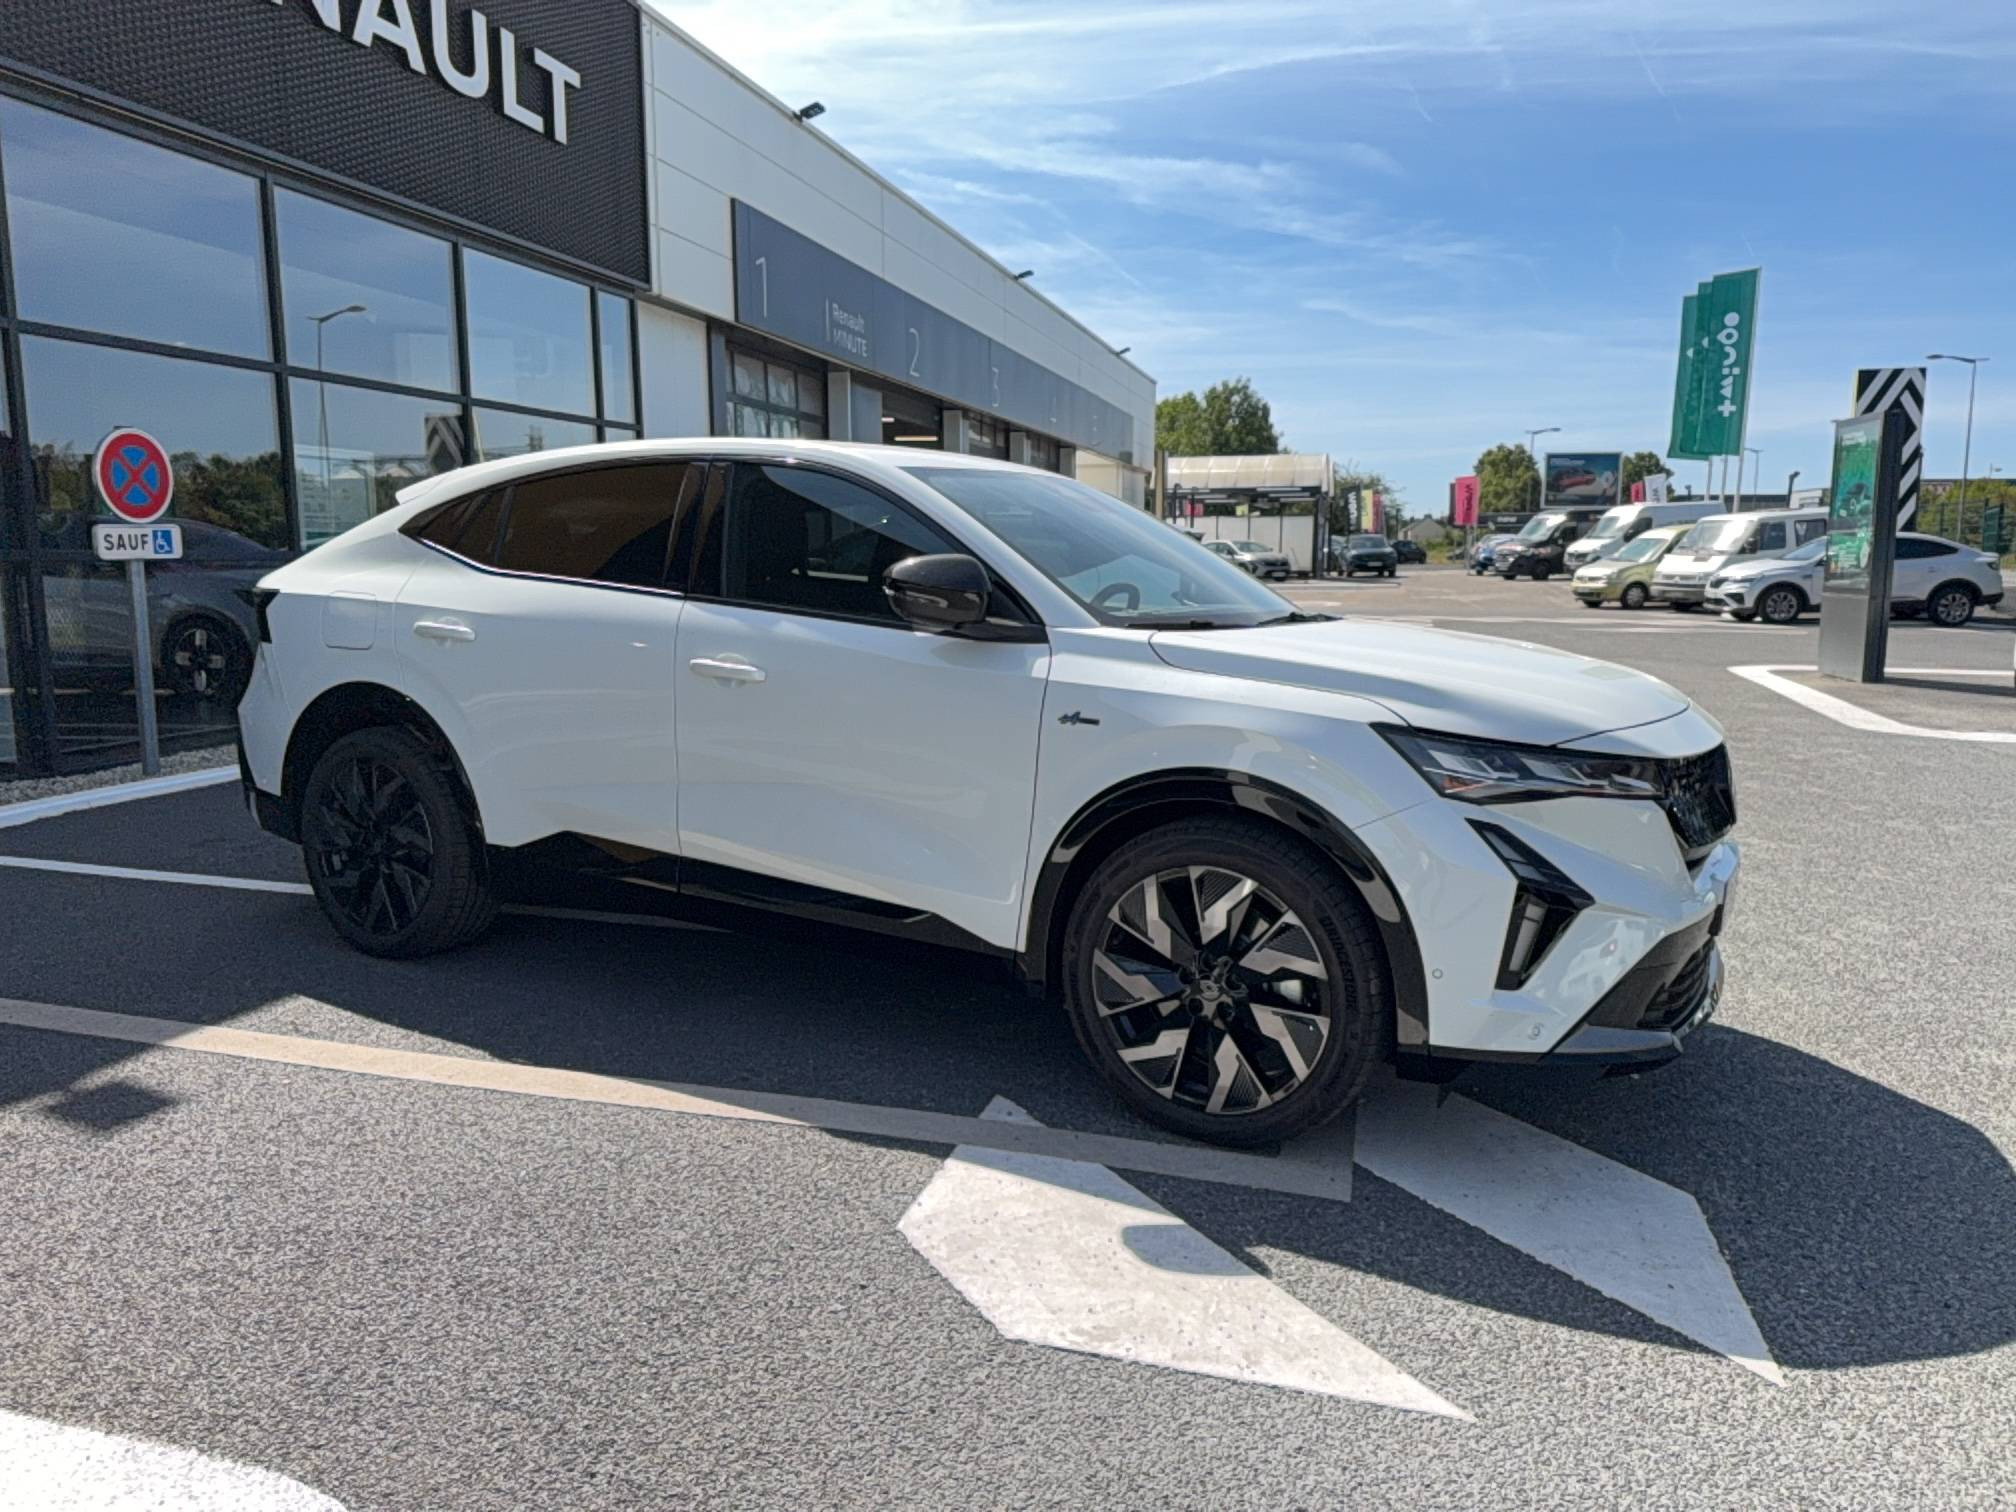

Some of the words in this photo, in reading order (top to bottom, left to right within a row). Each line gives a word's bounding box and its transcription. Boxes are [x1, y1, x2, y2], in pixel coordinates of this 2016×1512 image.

[755, 257, 768, 319] 1
[832, 303, 865, 334] Renault
[909, 327, 920, 378] 2
[991, 367, 1000, 408] 3
[103, 533, 149, 551] SAUF
